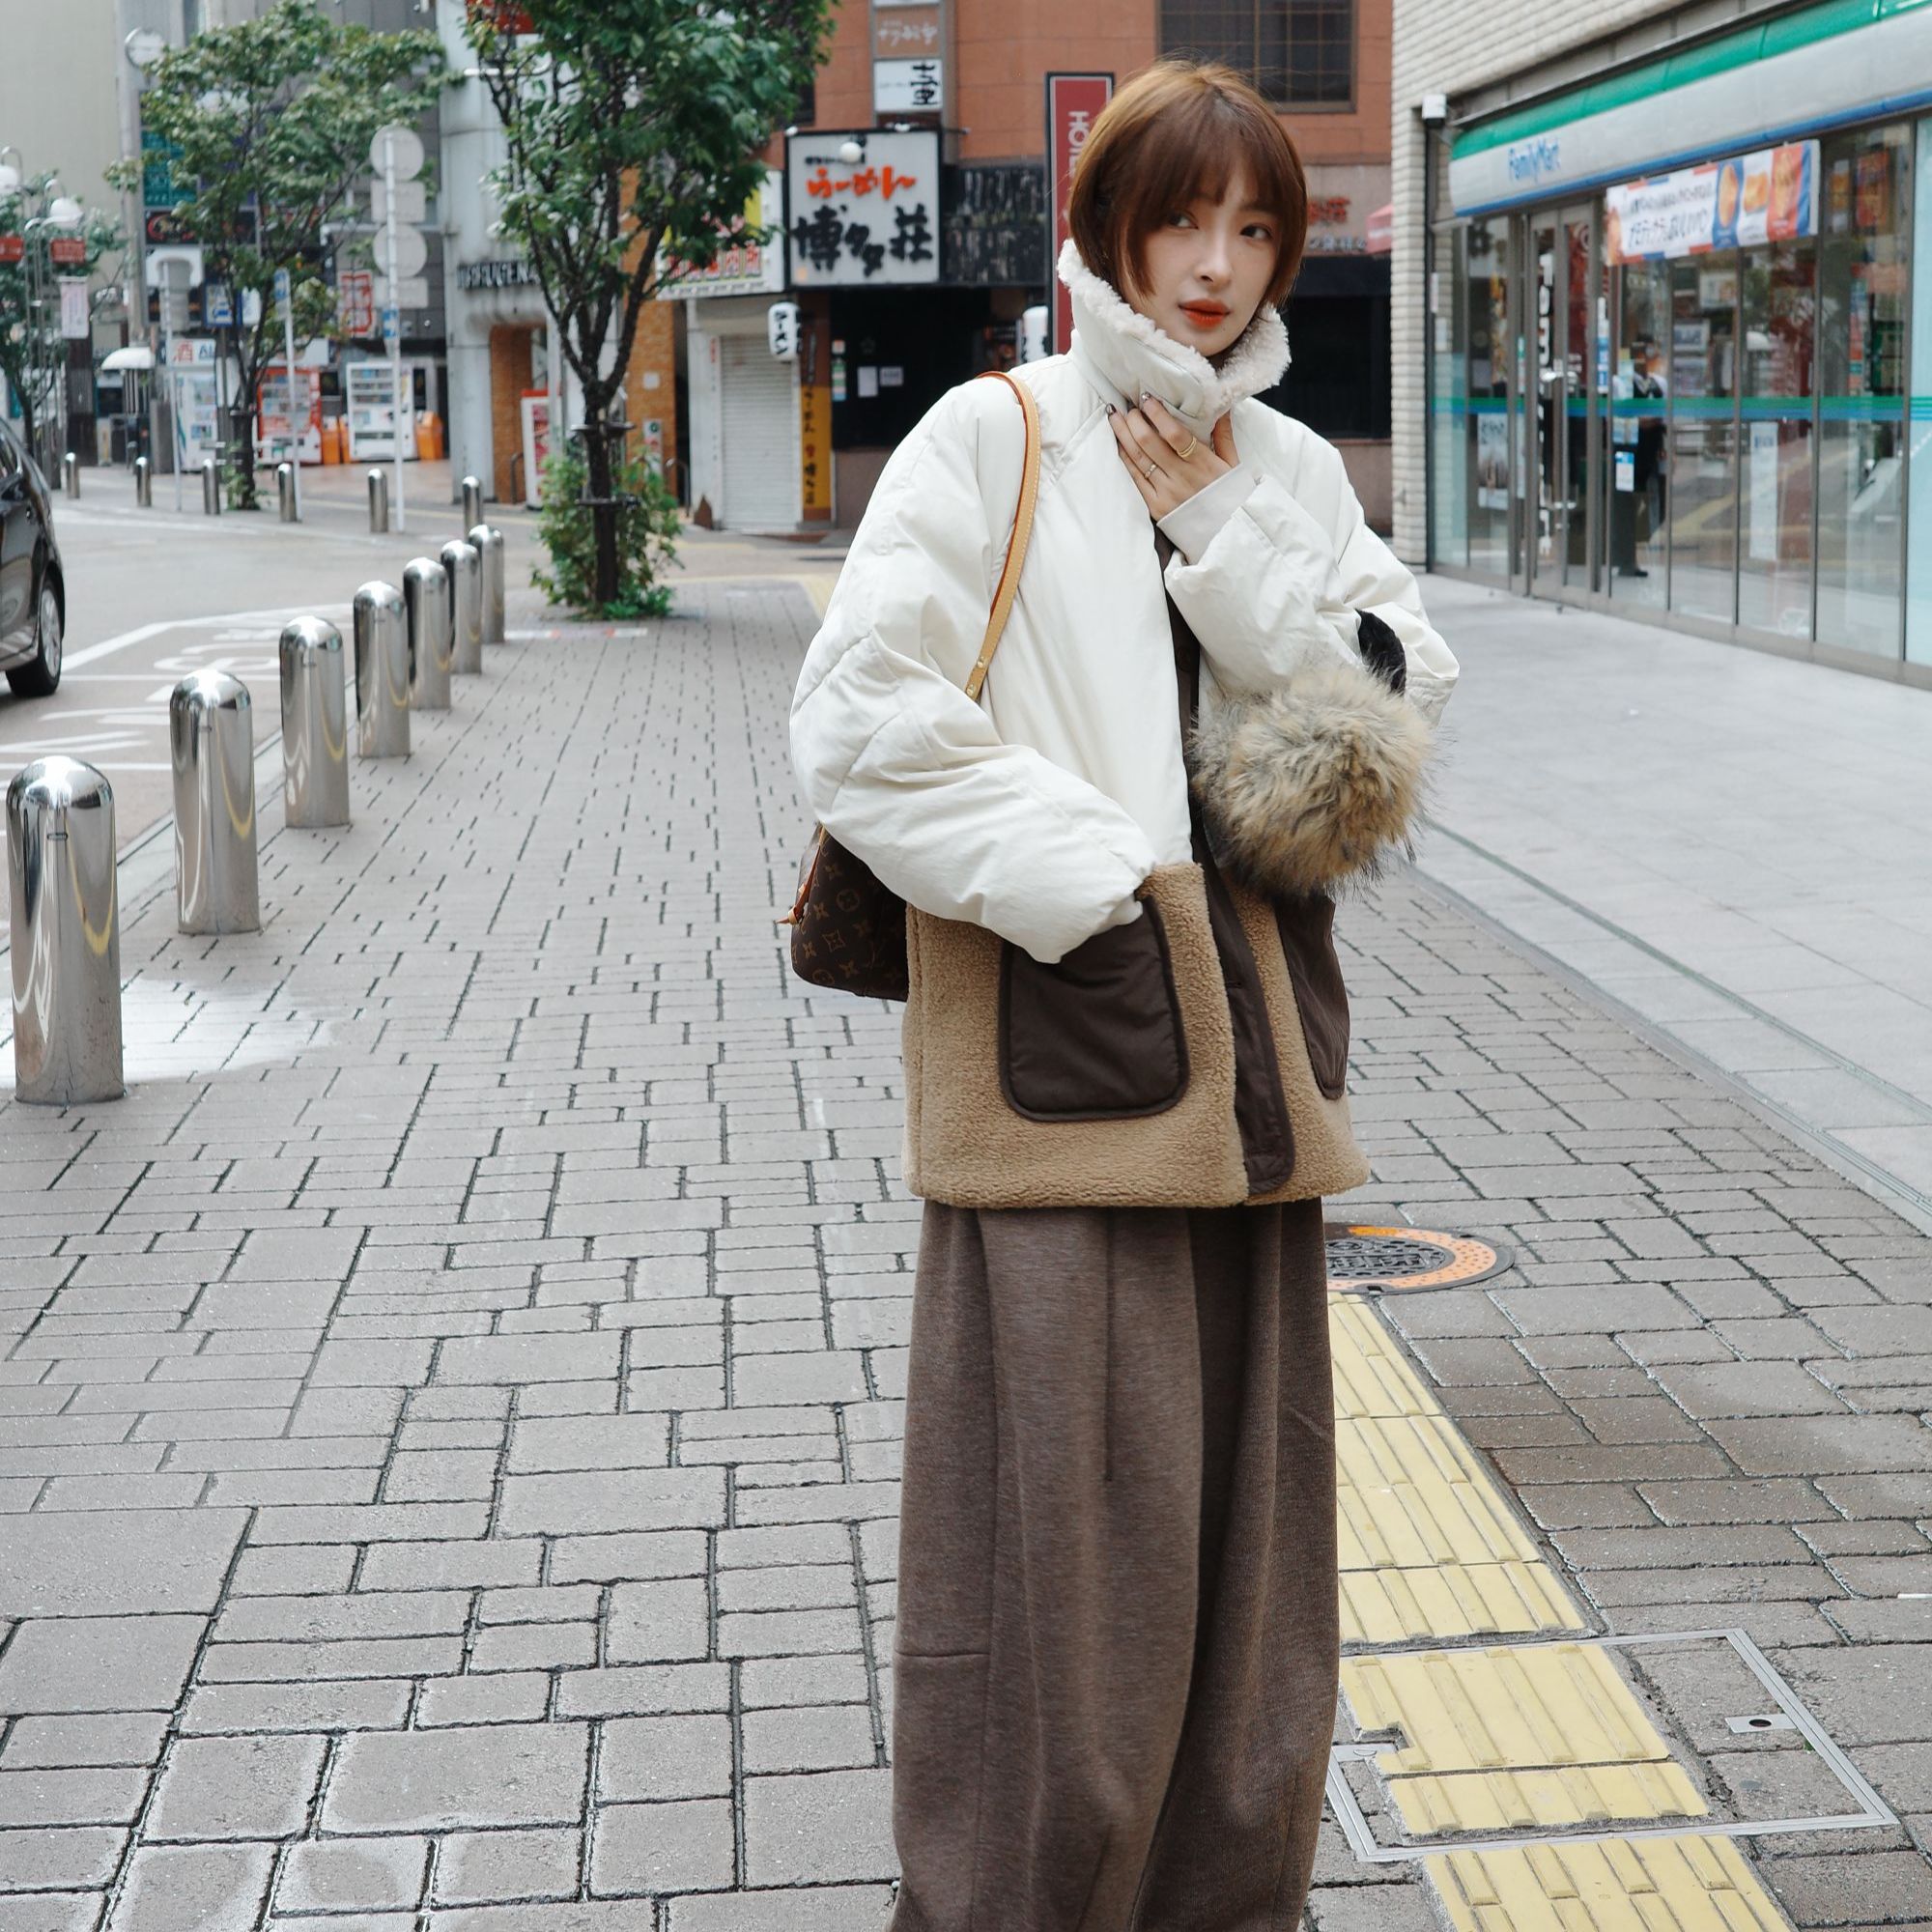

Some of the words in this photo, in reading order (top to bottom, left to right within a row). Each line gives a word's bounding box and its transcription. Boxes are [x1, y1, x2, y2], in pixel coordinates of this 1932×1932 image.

[1509, 139, 1561, 182] FamilyMart
[807, 165, 917, 201] らーめん
[791, 203, 933, 277] 博多荘
